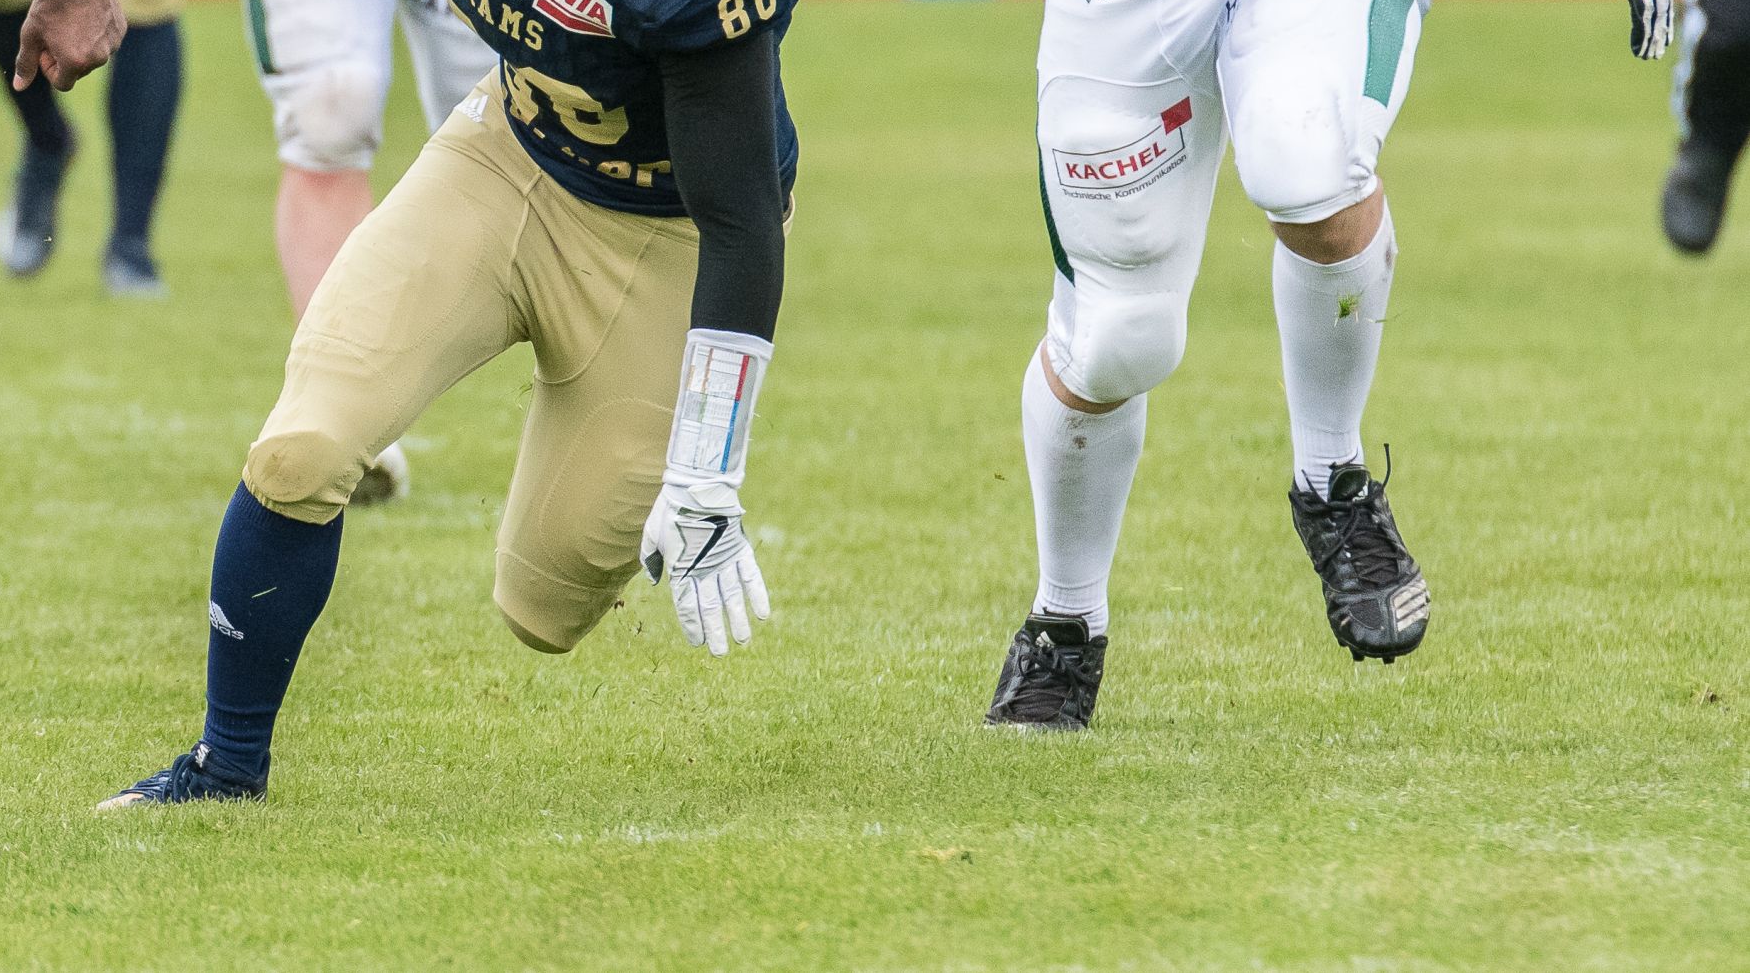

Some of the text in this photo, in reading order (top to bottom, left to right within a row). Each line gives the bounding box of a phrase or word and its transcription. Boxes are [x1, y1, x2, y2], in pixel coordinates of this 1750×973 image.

[1062, 154, 1187, 200] Technische Kommunikation
[1065, 141, 1167, 180] KACHEL
